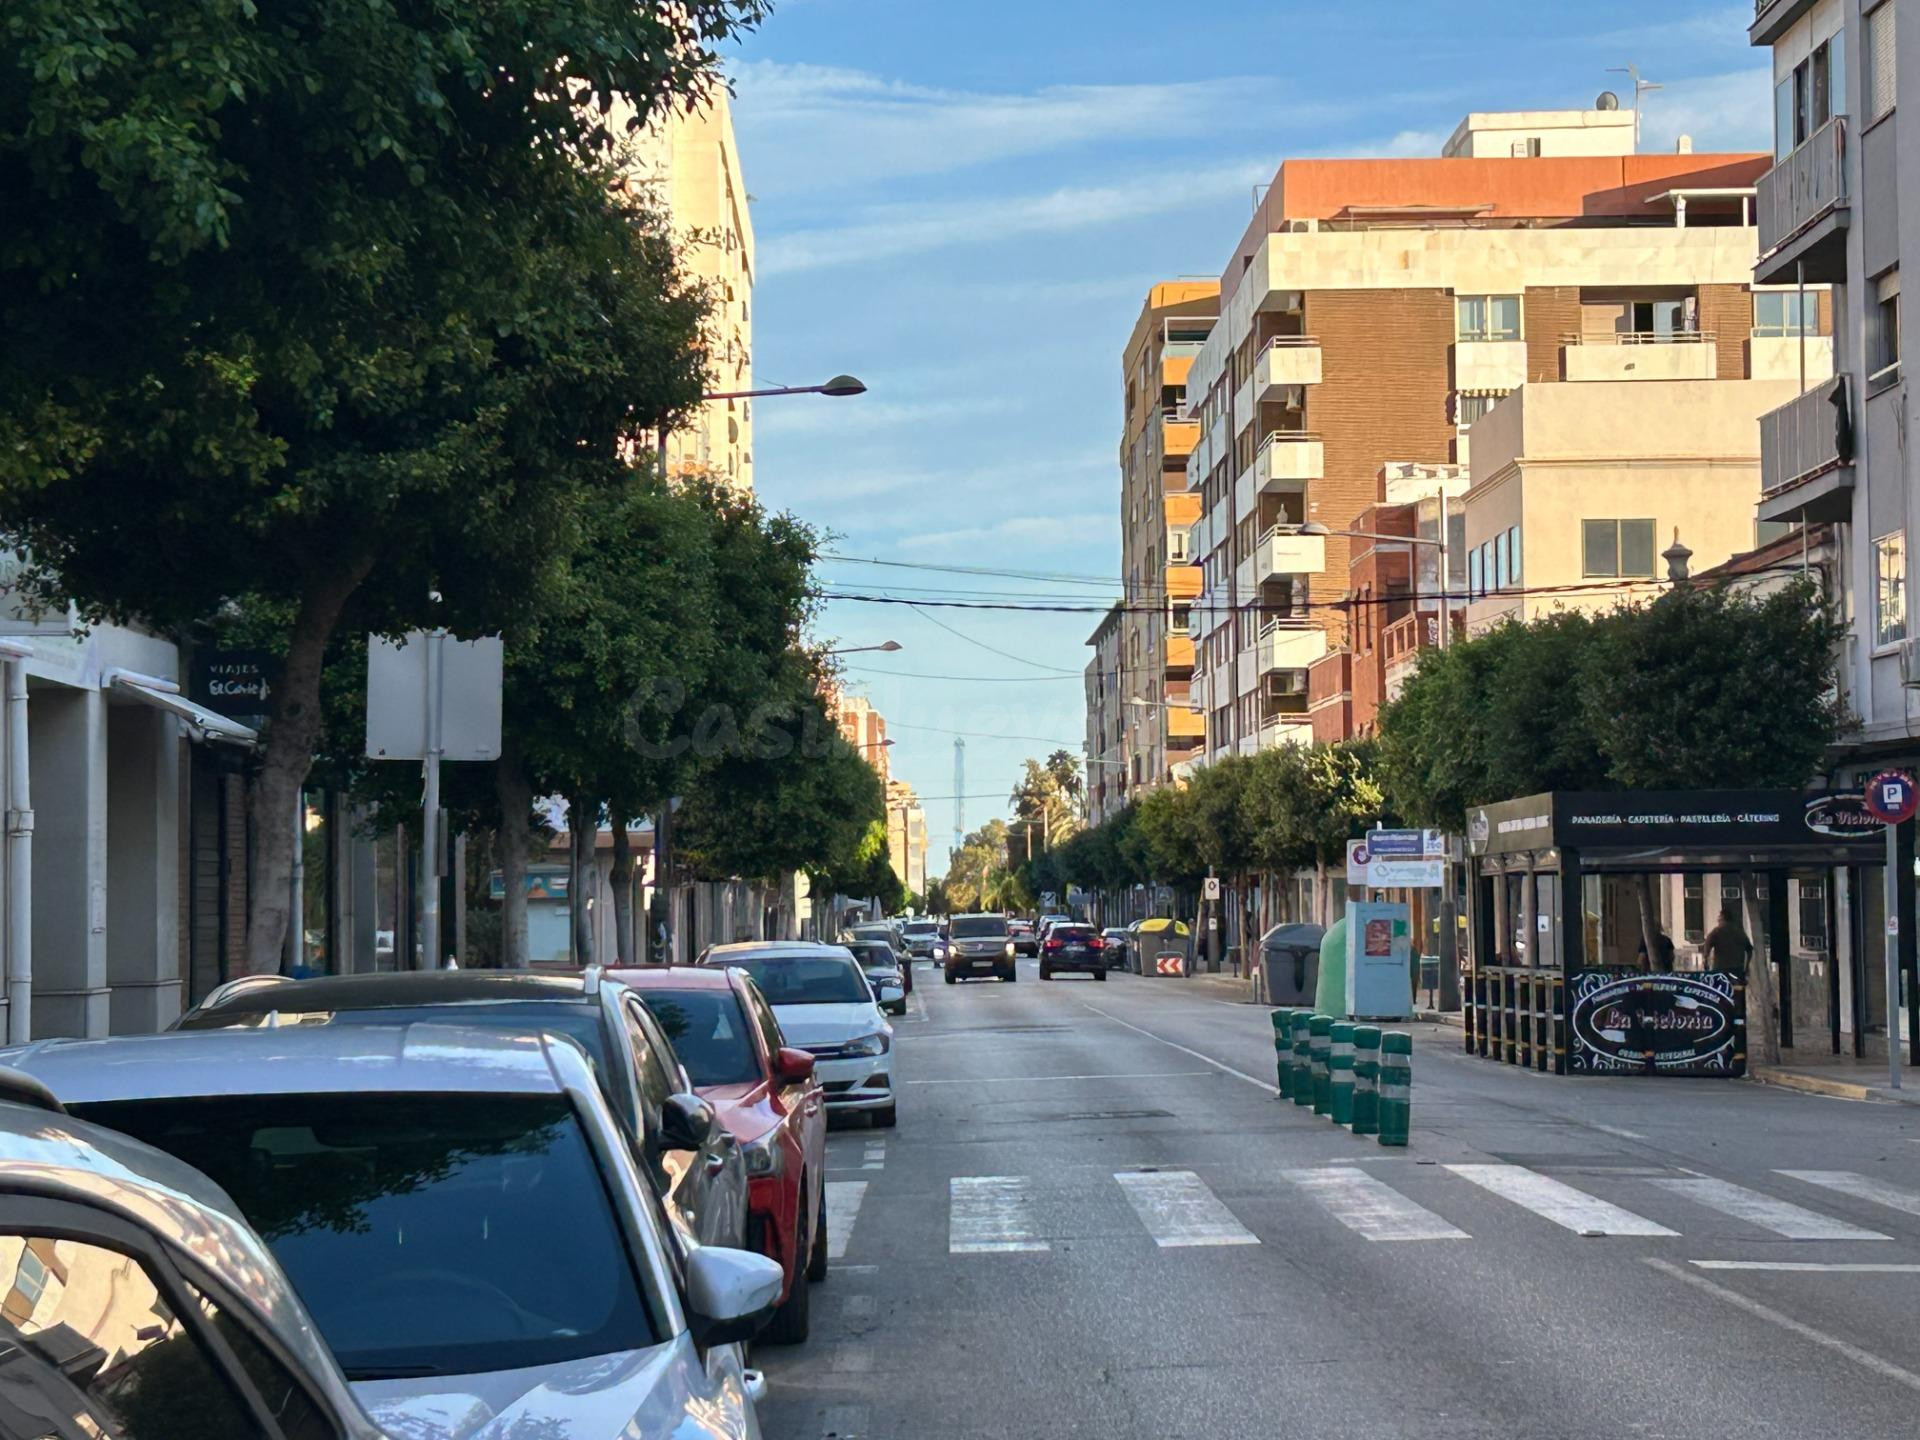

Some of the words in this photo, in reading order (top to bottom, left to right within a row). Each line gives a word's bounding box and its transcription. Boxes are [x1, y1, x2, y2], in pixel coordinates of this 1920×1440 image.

[210, 664, 260, 675] VIAJES
[1887, 787, 1897, 800] P
[1604, 1007, 1632, 1029] La
